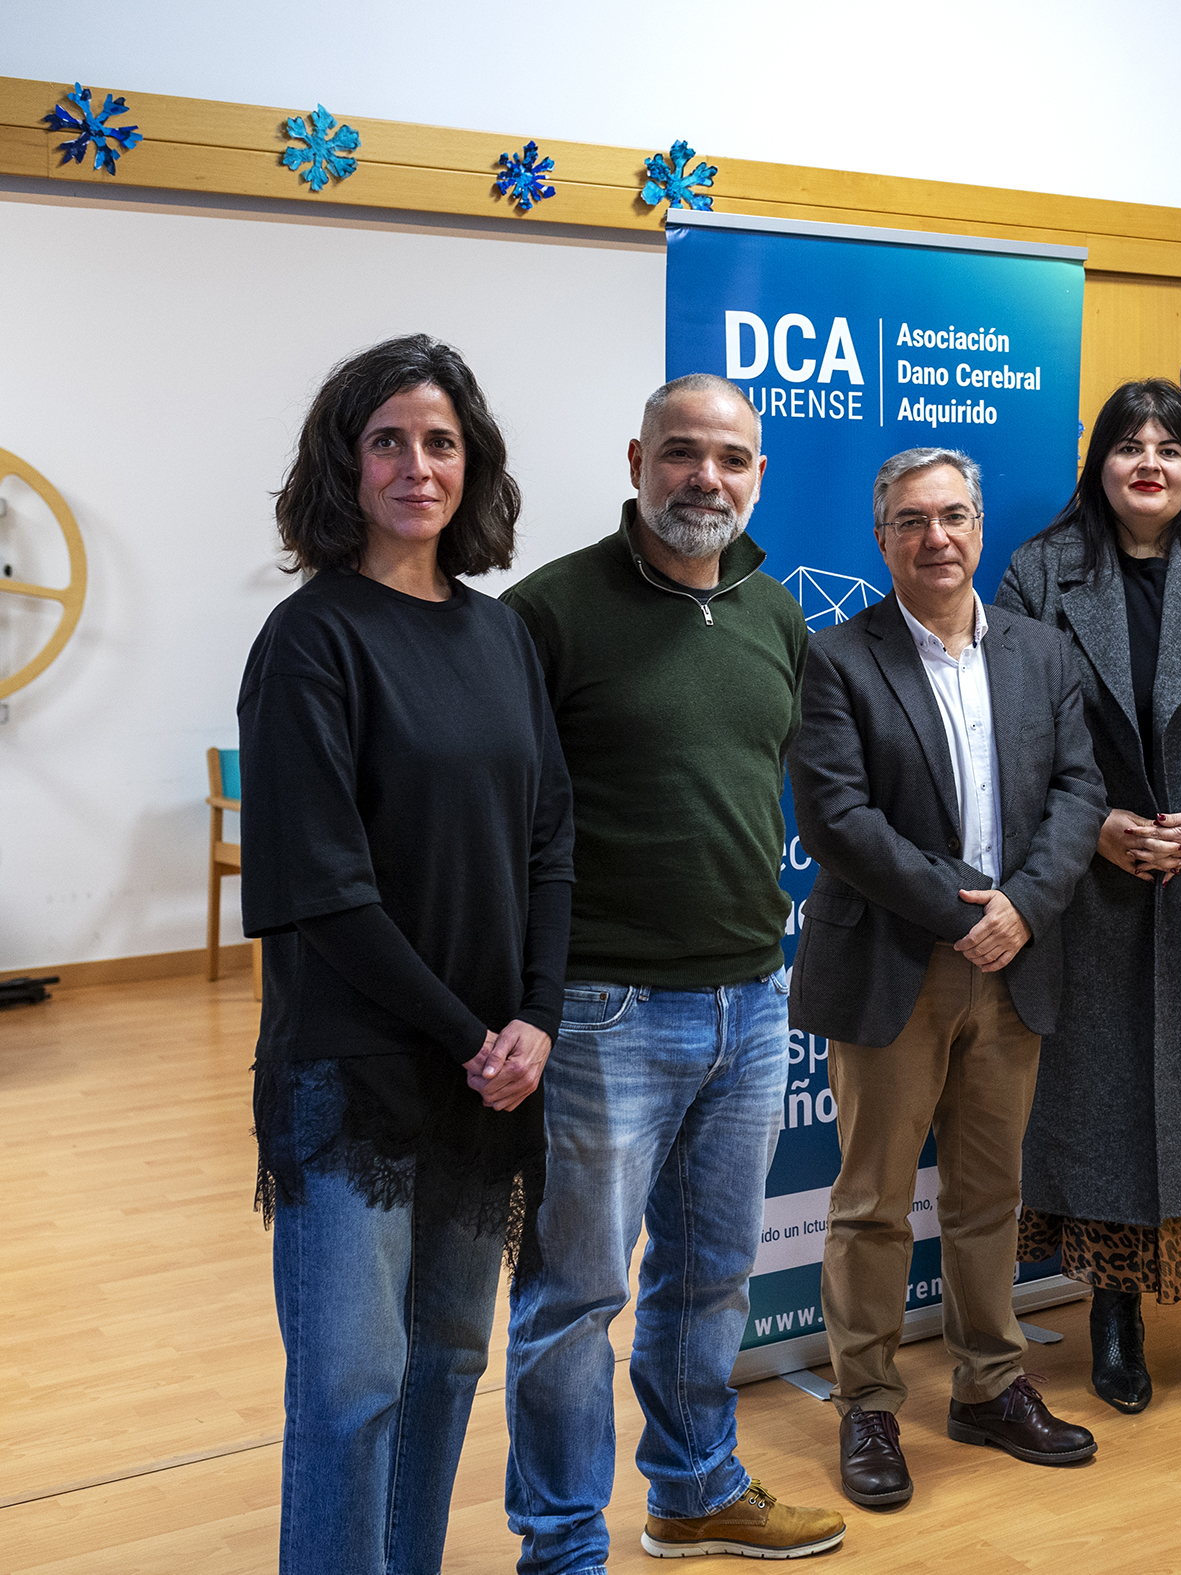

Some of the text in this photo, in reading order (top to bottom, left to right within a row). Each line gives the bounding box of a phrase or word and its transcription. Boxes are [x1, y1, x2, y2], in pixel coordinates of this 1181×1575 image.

[725, 310, 865, 385] DCA
[896, 322, 1010, 353] Asociación
[897, 360, 1041, 391] Dano Cerebral
[740, 387, 864, 420] URENSE
[897, 397, 998, 429] Adquirido
[780, 1078, 838, 1130] ño
[784, 1226, 799, 1239] un
